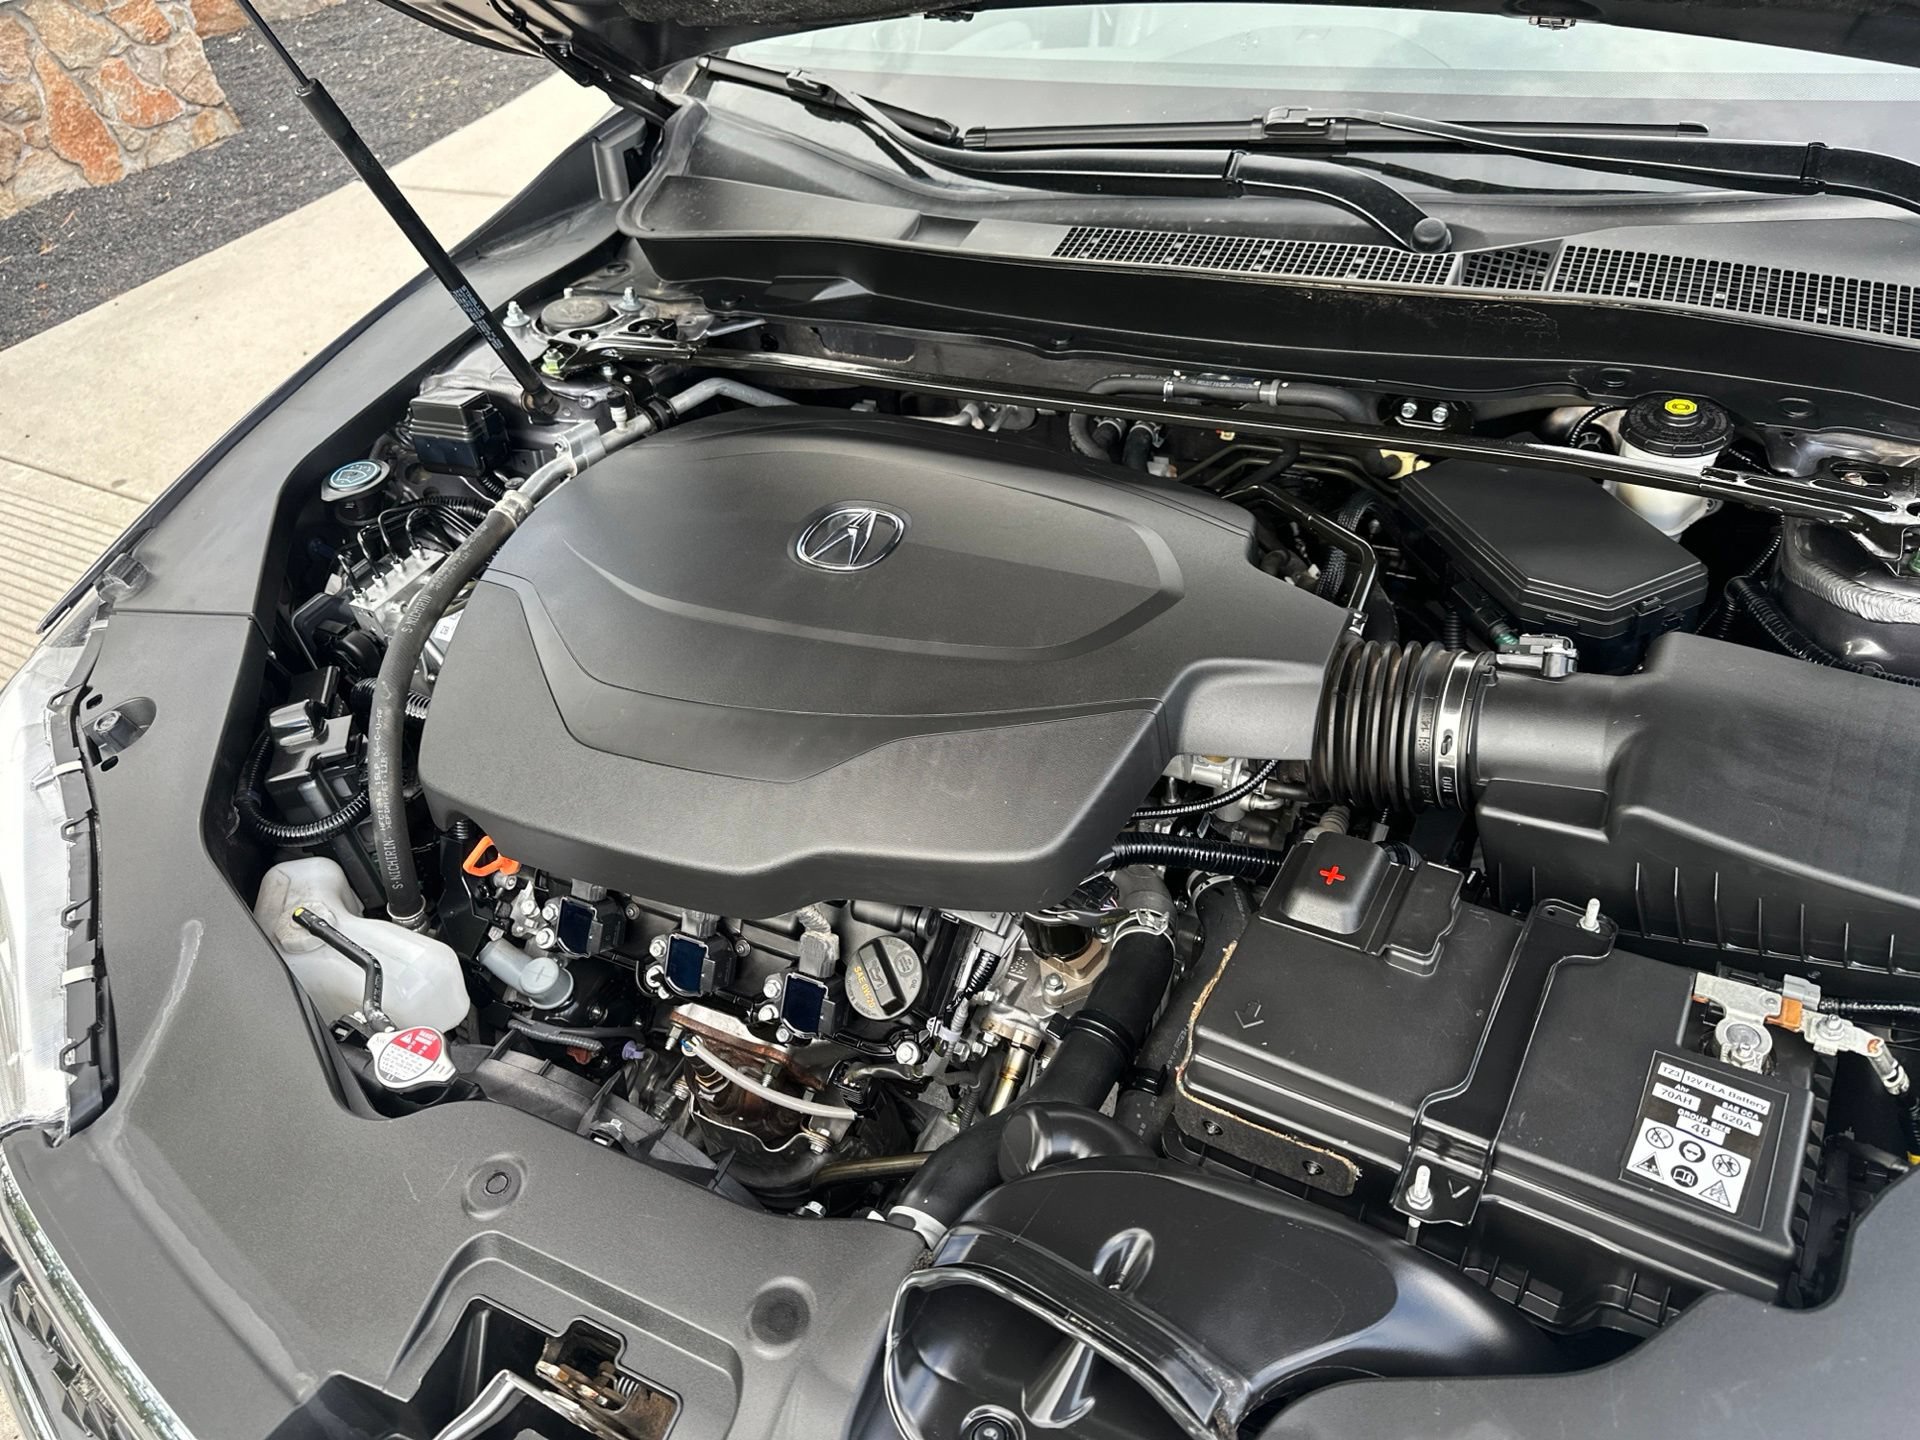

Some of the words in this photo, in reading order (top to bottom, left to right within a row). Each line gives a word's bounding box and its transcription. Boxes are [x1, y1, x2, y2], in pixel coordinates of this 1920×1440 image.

[854, 966, 866, 984] SAE
[1663, 1067, 1680, 1078] TZ3
[1661, 1088, 1693, 1105] 70AH
[1686, 1075, 1701, 1085] 12V
[1705, 1082, 1725, 1094] FLA
[1728, 1091, 1767, 1111] Battery
[1677, 1108, 1708, 1124] GROUP
[1721, 1112, 1752, 1130] 620A
[1691, 1125, 1711, 1137] 48
